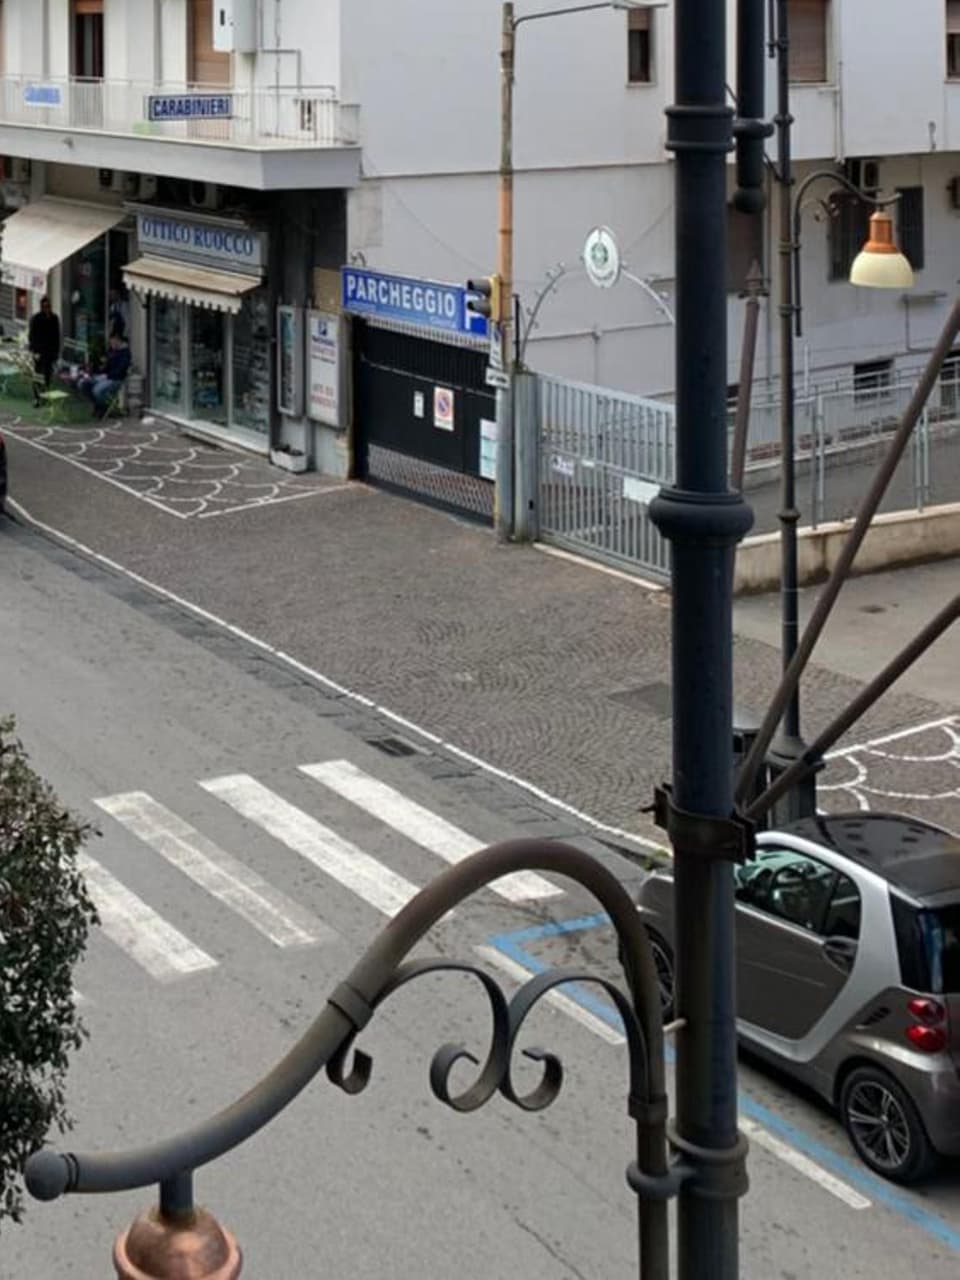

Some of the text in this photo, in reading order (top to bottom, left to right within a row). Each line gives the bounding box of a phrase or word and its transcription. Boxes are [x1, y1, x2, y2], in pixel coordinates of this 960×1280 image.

[153, 98, 229, 117] CARABINIERI
[142, 217, 254, 257] OTTICO RUOCCO
[346, 274, 457, 318] PARCHEGGIO
